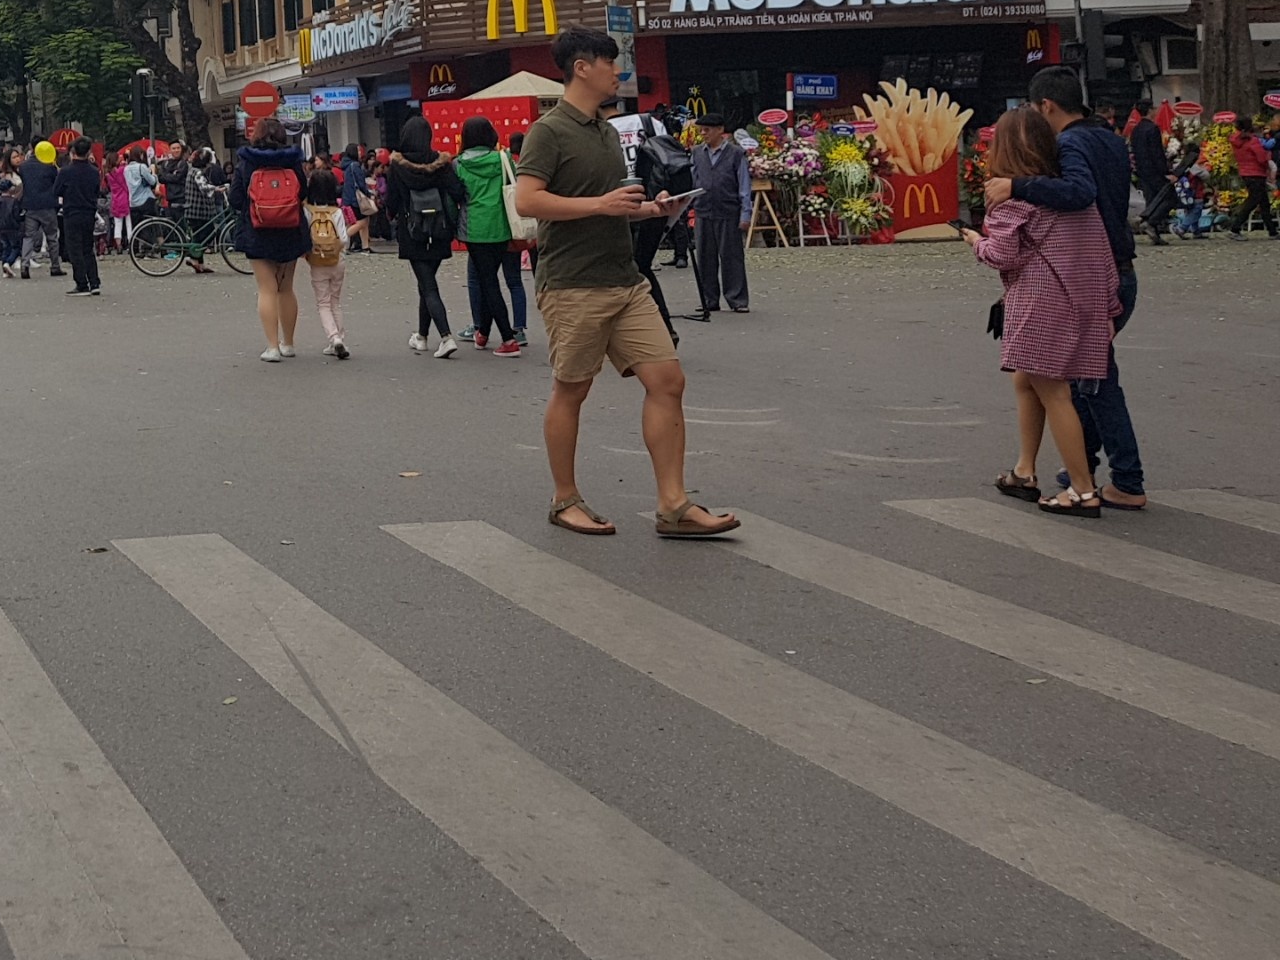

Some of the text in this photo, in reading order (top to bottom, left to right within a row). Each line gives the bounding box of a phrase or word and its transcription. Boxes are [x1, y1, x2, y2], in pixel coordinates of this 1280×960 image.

[980, 6, 1002, 18] (024)
[1005, 4, 1045, 16] 39338080
[648, 16, 660, 29] SỐ
[662, 18, 672, 28] 02
[674, 16, 698, 28] HÀNG
[311, 10, 378, 62] McDonald's
[796, 83, 834, 95] HÀNG KHAY
